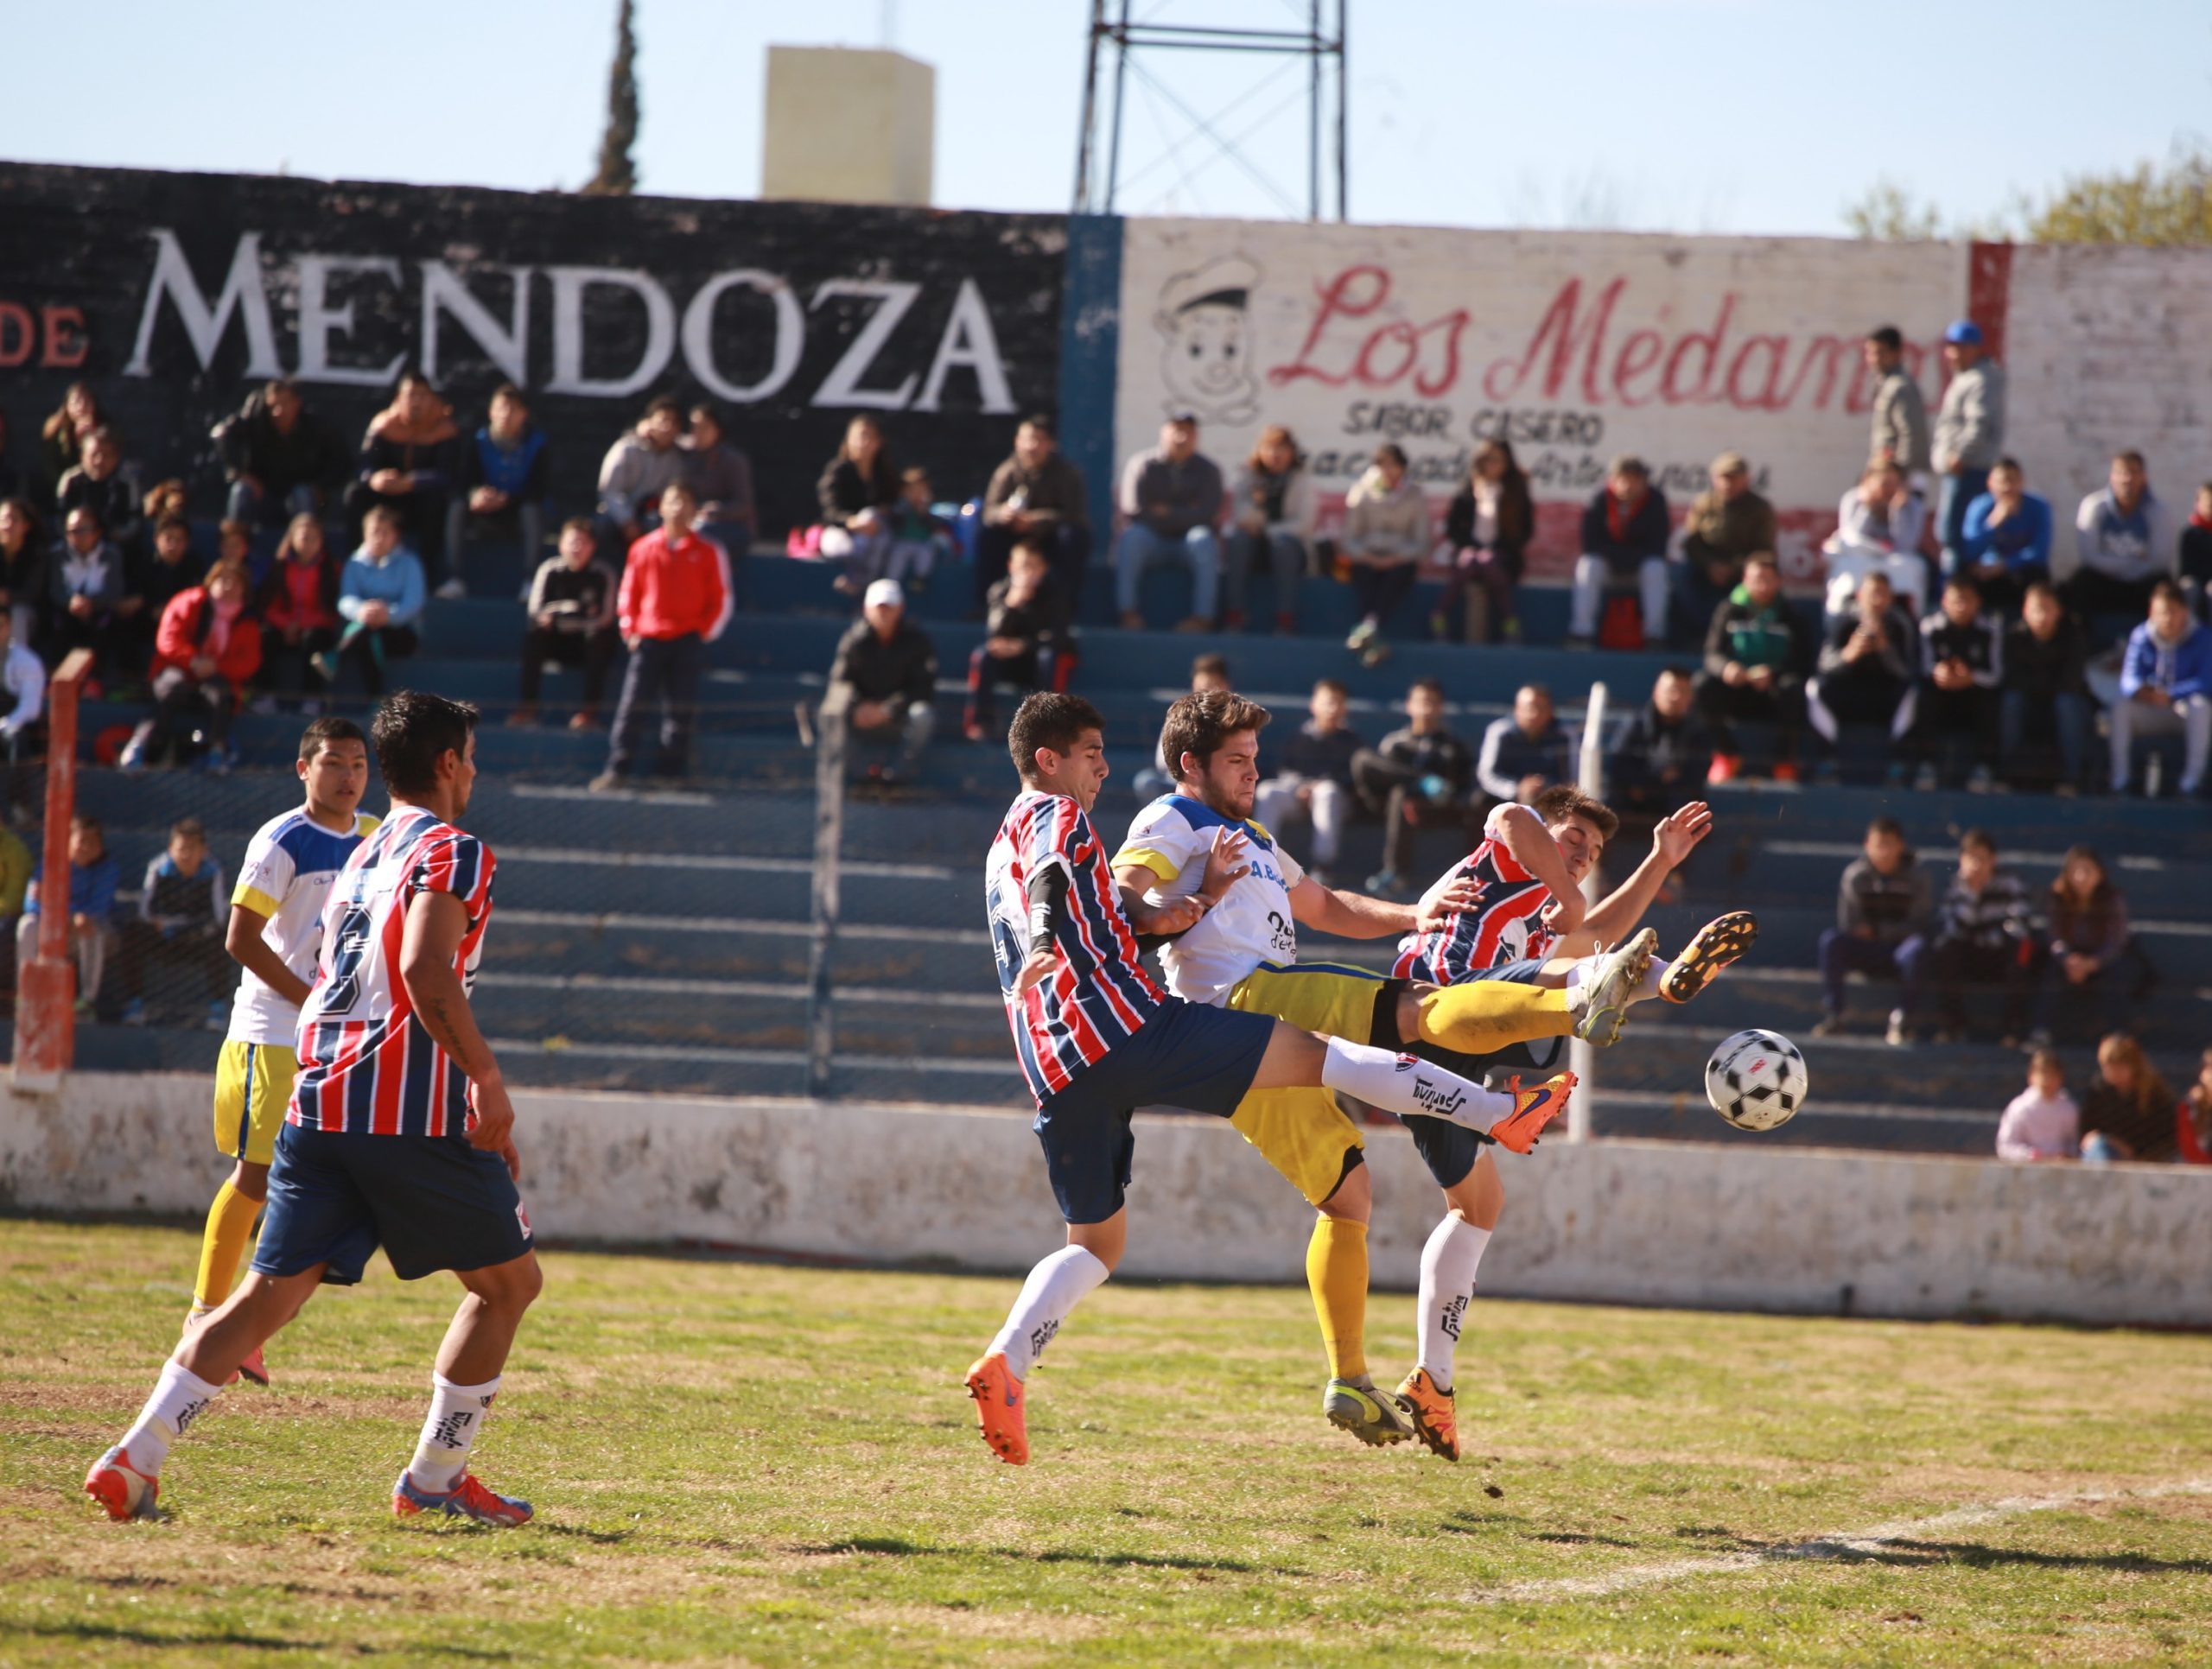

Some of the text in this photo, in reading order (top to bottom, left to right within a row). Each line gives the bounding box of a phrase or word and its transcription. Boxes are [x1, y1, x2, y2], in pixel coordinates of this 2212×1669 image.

[0, 227, 1018, 414] DE MENDOZA
[1268, 264, 1955, 415] Los Médan
[1342, 400, 1605, 447] SABOR CASERO
[1413, 1078, 1466, 1115] Sporting
